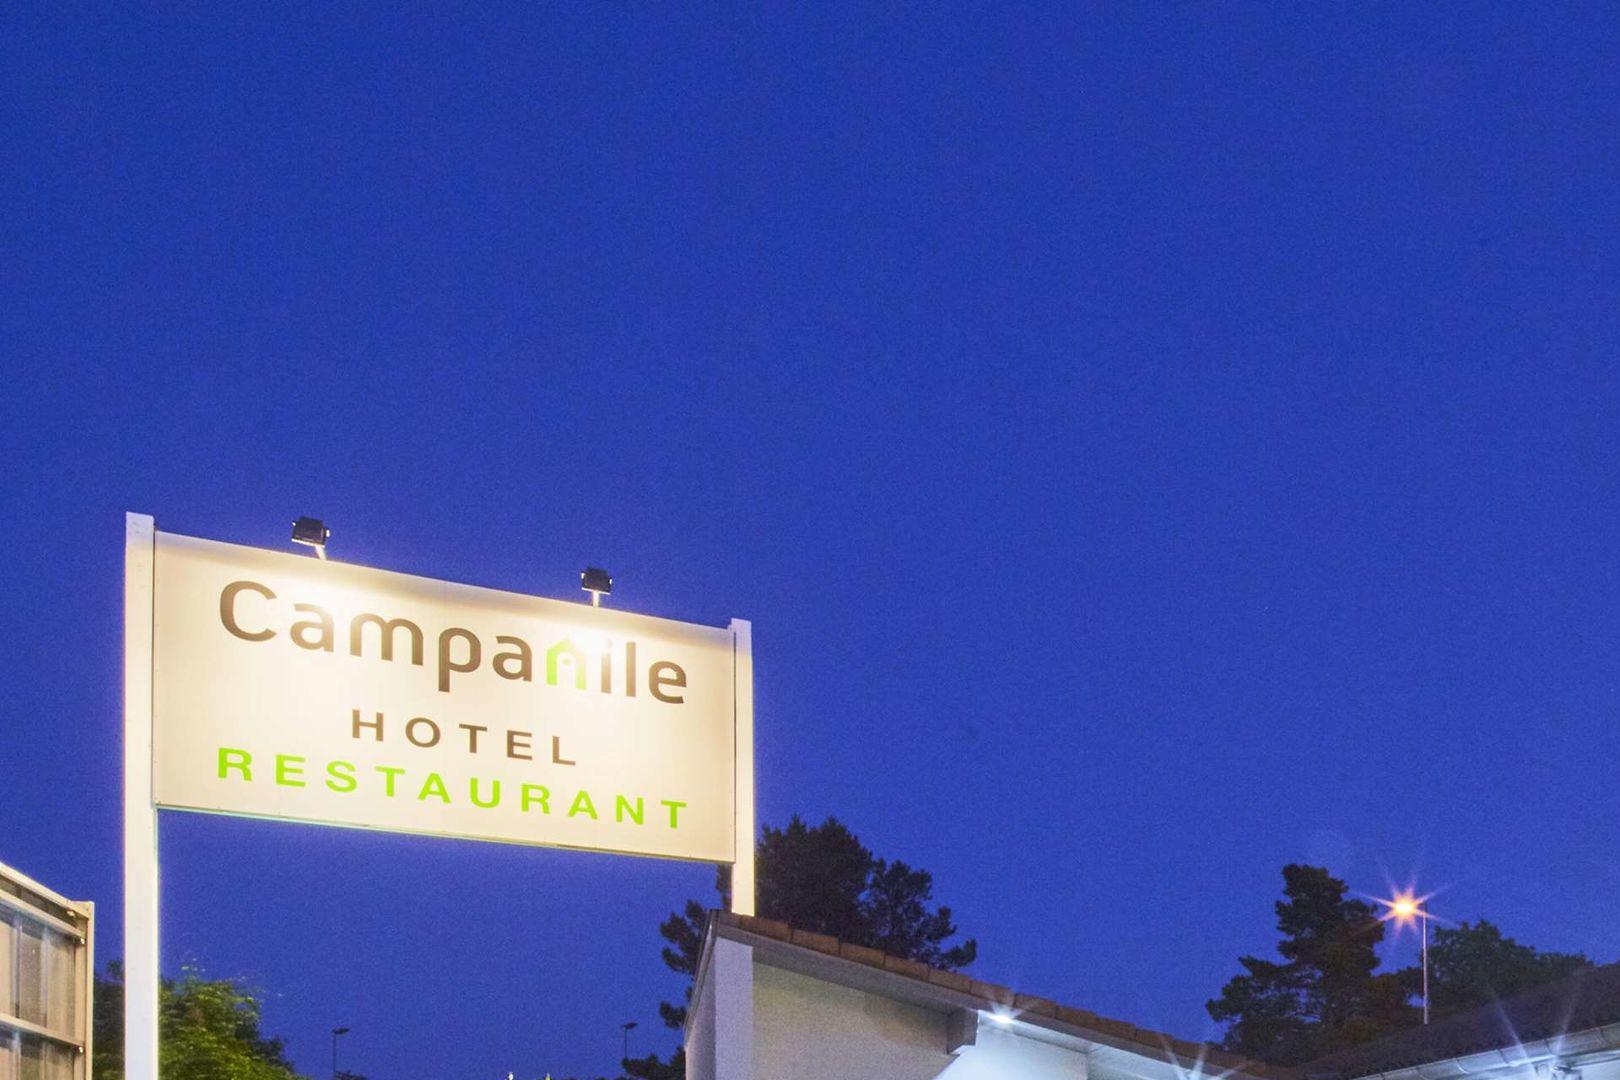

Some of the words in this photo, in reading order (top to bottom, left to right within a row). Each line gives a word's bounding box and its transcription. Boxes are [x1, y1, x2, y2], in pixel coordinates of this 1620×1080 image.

[218, 580, 687, 705] Campanile
[351, 708, 577, 766] HOTEL
[217, 747, 687, 829] RESTAURANT
